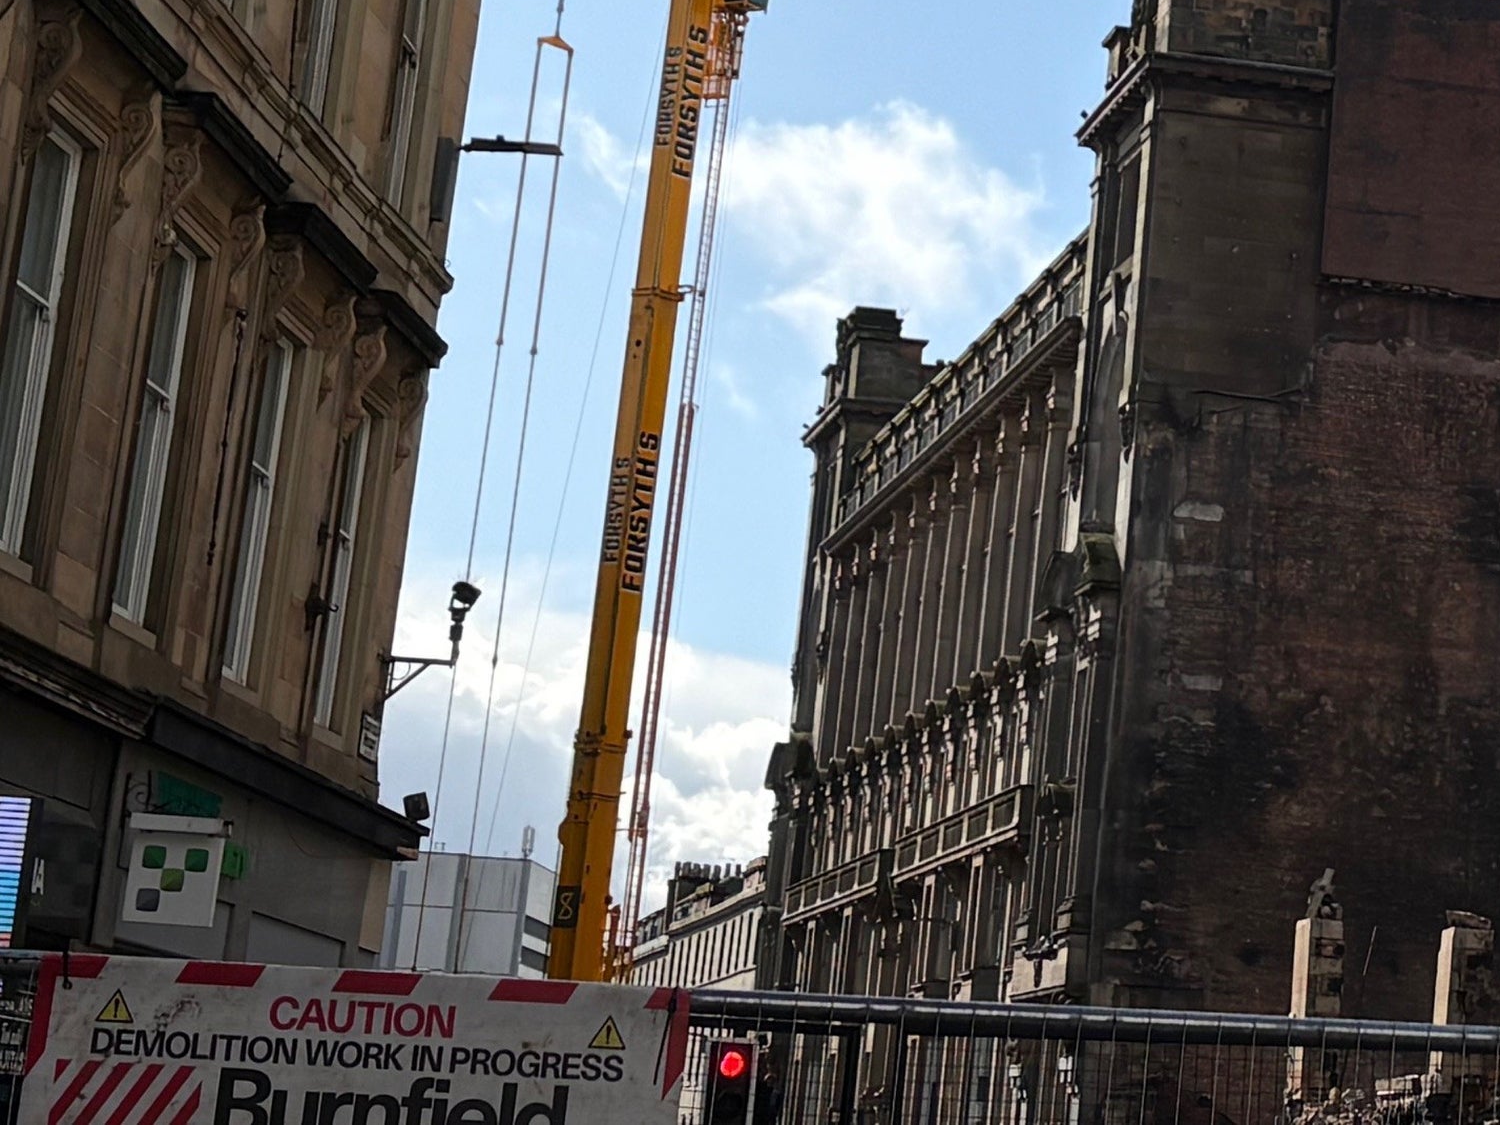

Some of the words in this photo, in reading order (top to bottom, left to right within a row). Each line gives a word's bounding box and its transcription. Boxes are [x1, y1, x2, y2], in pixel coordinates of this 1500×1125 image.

[671, 24, 709, 178] FORSYTH'S
[621, 431, 659, 592] FORSYTH'S
[90, 1028, 298, 1065] DEMOLITION
[305, 1038, 406, 1071] WORK
[411, 1044, 444, 1073] IN
[449, 1046, 624, 1083] PROGRESS
[269, 995, 456, 1039] CAUTION
